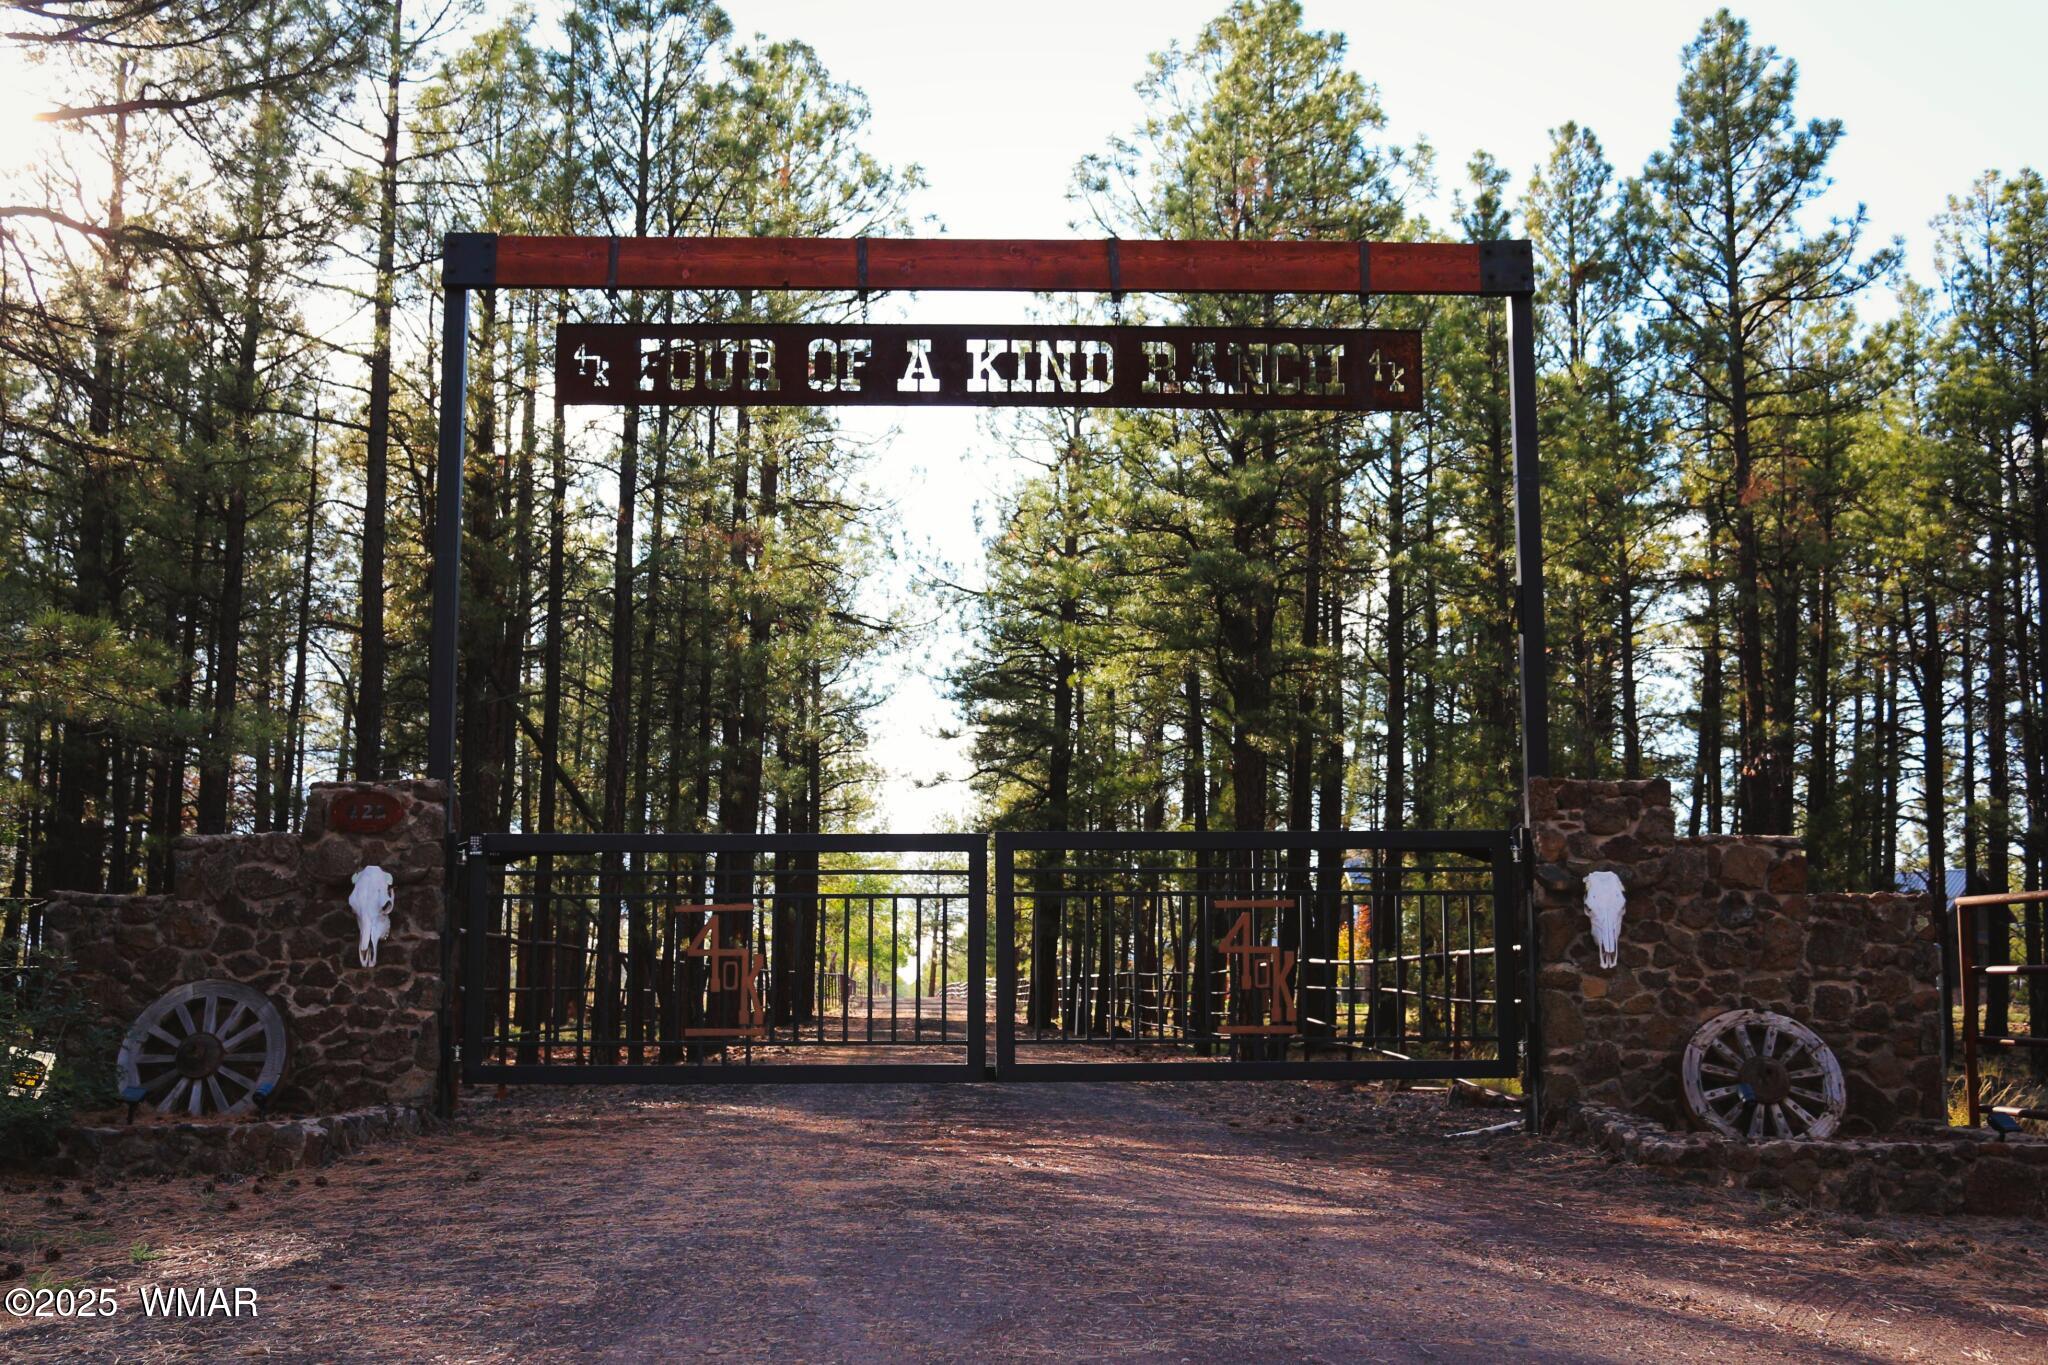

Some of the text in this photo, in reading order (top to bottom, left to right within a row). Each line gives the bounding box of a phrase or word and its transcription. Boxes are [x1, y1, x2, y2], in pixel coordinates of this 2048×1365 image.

[636, 338, 781, 392] FOUR
[807, 338, 872, 392] OF
[896, 338, 941, 393] A
[965, 338, 1115, 393] KIND
[1141, 340, 1346, 394] RANCH
